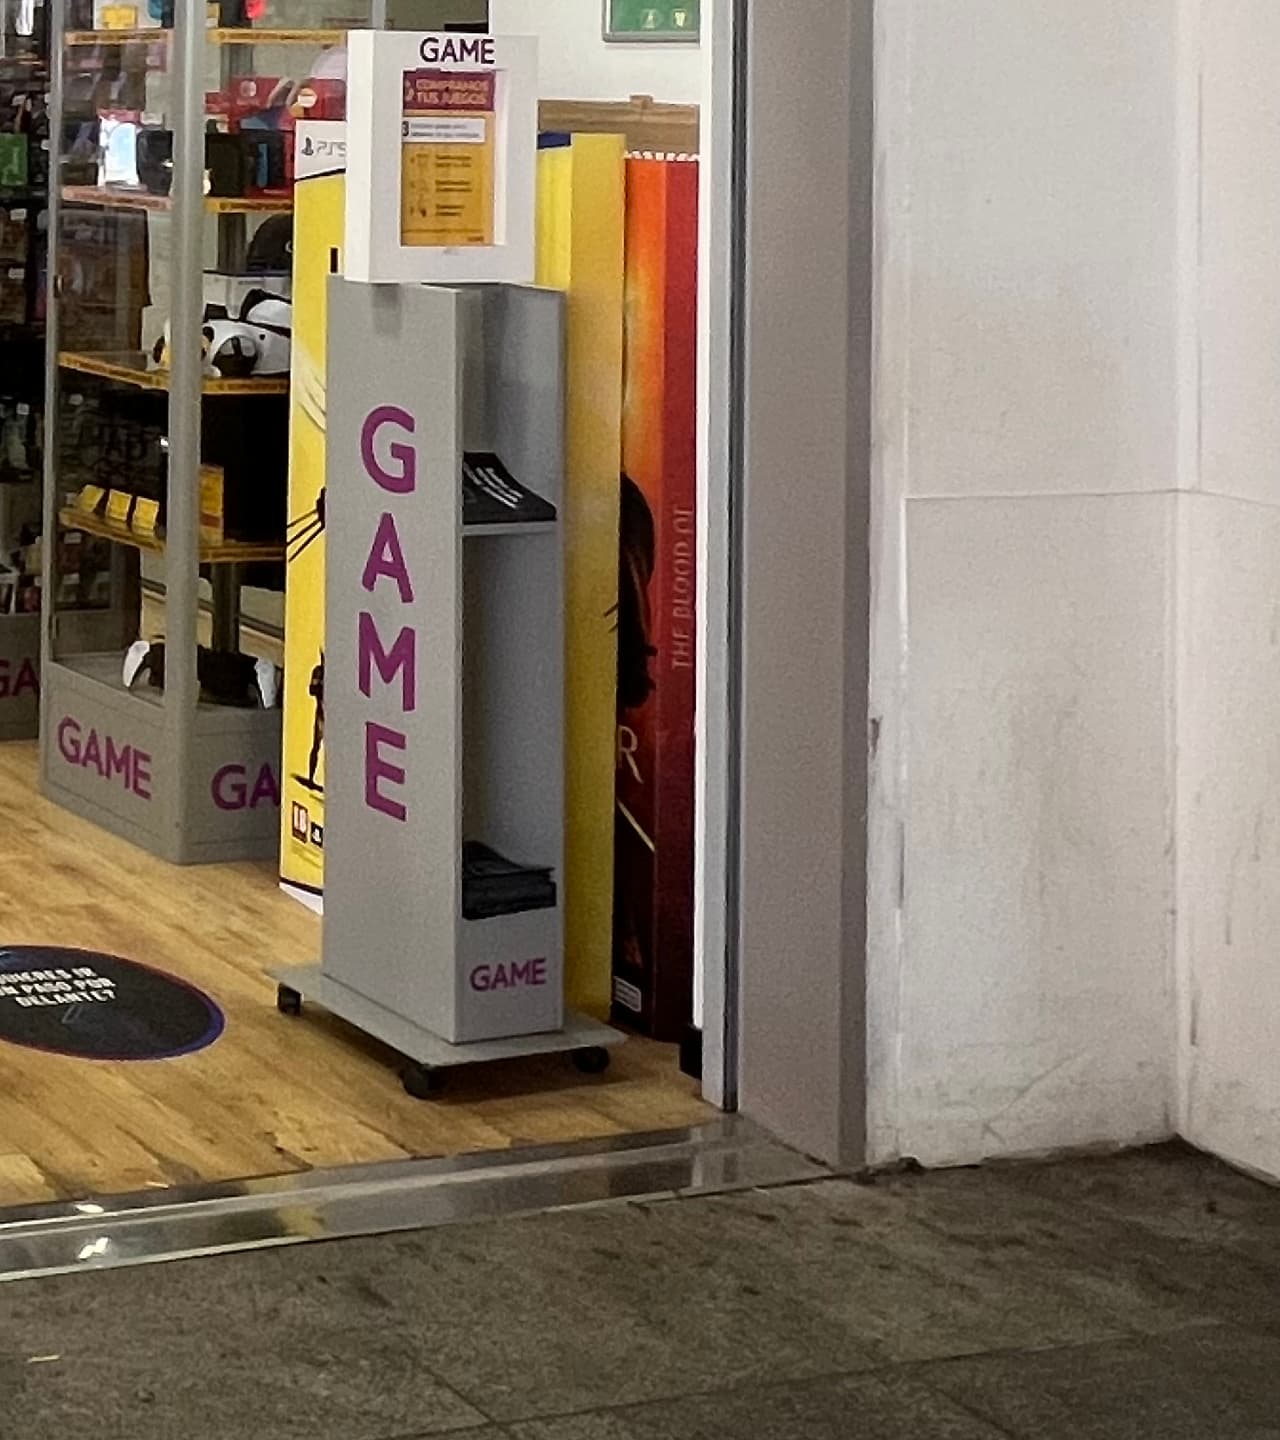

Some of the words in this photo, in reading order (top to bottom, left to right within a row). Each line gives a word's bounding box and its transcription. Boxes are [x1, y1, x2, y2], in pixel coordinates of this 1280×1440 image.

[418, 36, 496, 65] GAME
[671, 540, 693, 619] BLOOD
[358, 404, 416, 823] GAME
[56, 715, 152, 801] GAME
[210, 763, 282, 811] GA
[14, 988, 117, 1008] DELANTE?
[469, 957, 547, 993] GAME
